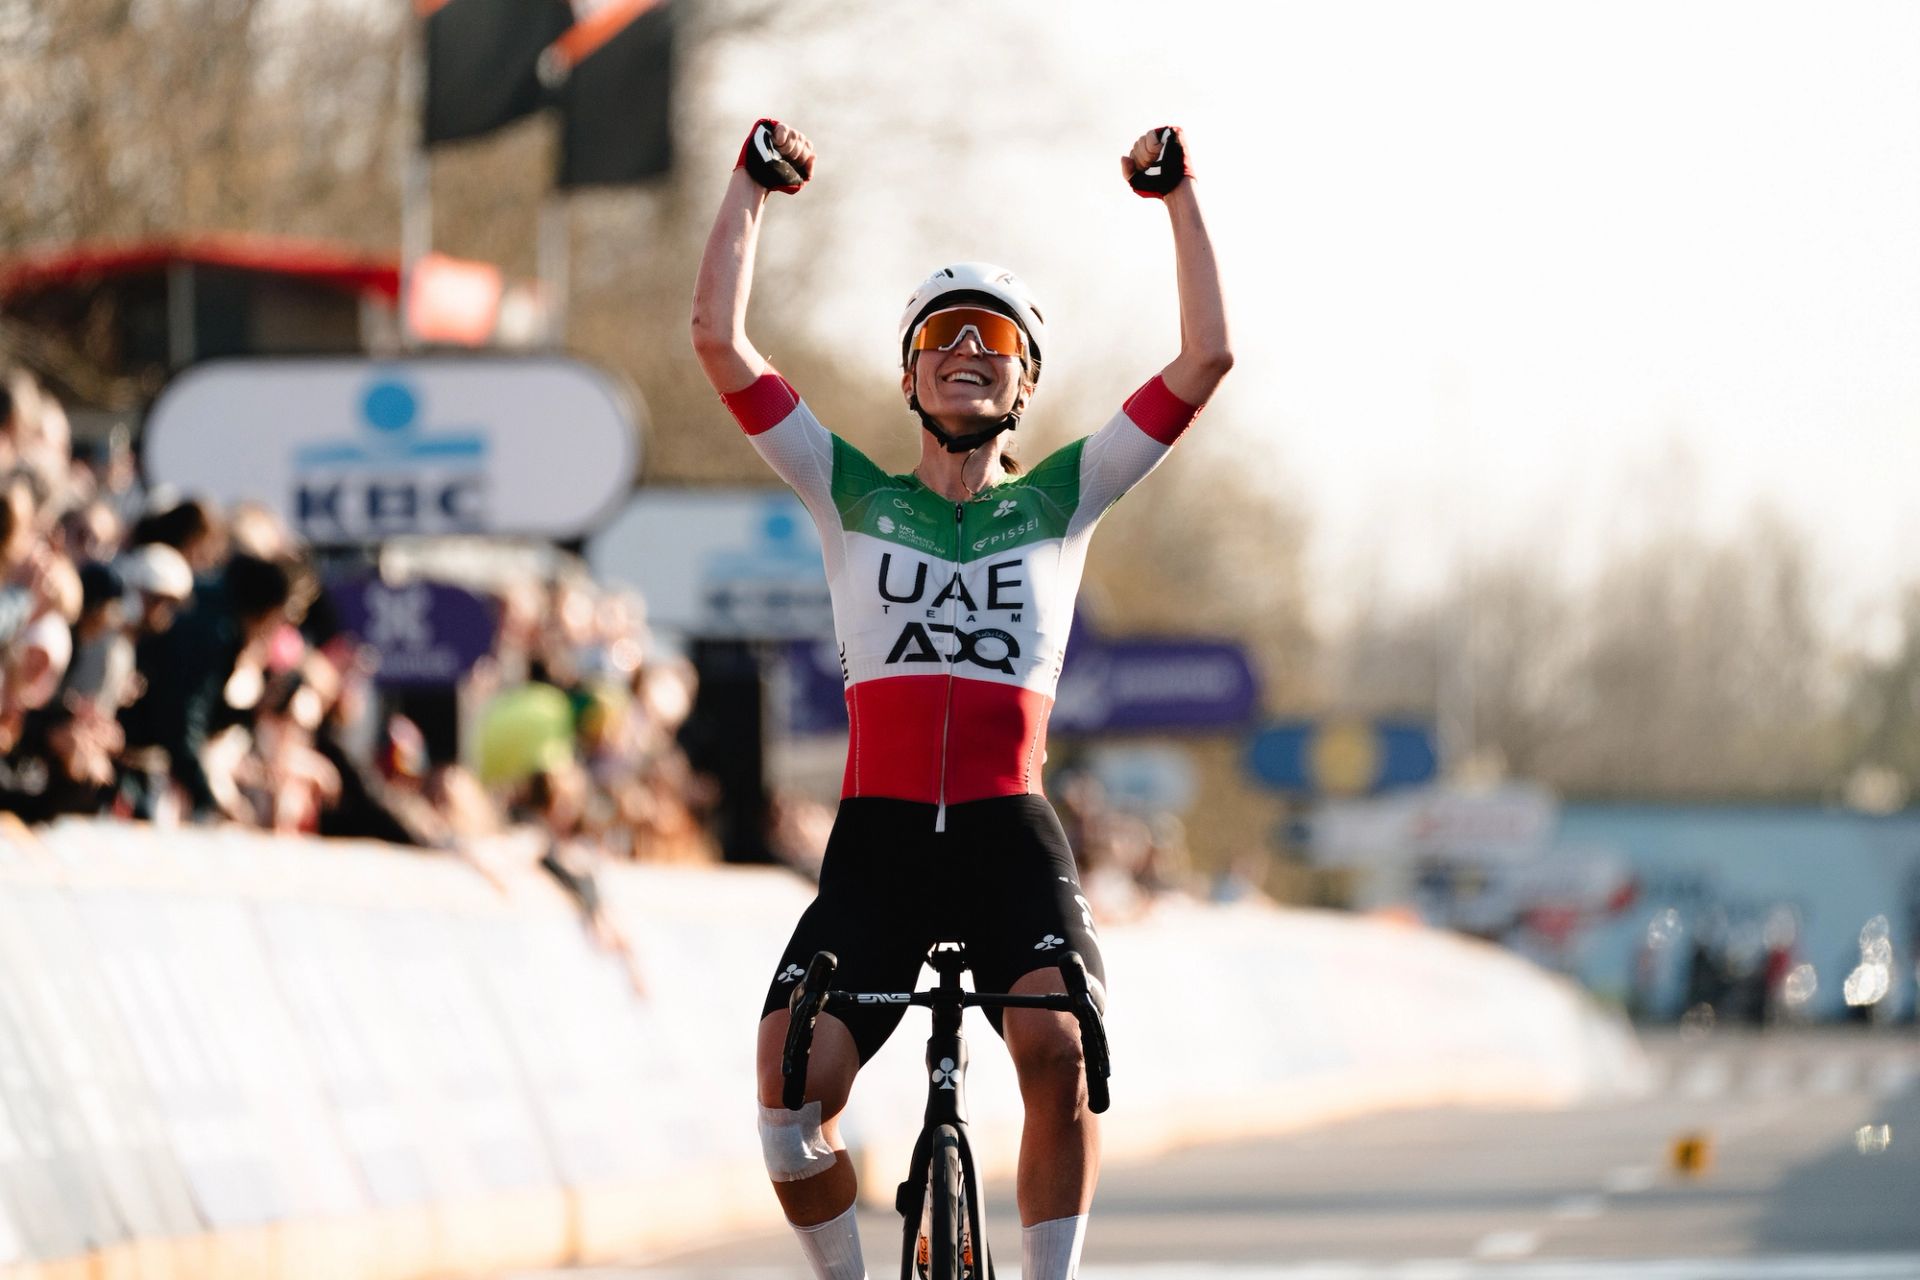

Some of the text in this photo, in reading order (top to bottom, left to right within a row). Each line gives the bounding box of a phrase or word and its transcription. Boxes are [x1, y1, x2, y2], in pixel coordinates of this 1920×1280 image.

[295, 480, 489, 541] KBC
[899, 524, 915, 535] UCI
[991, 517, 1039, 545] PISSEI
[878, 553, 1024, 611] UAE
[882, 604, 1021, 623] TEAM
[885, 622, 1021, 675] ADQ
